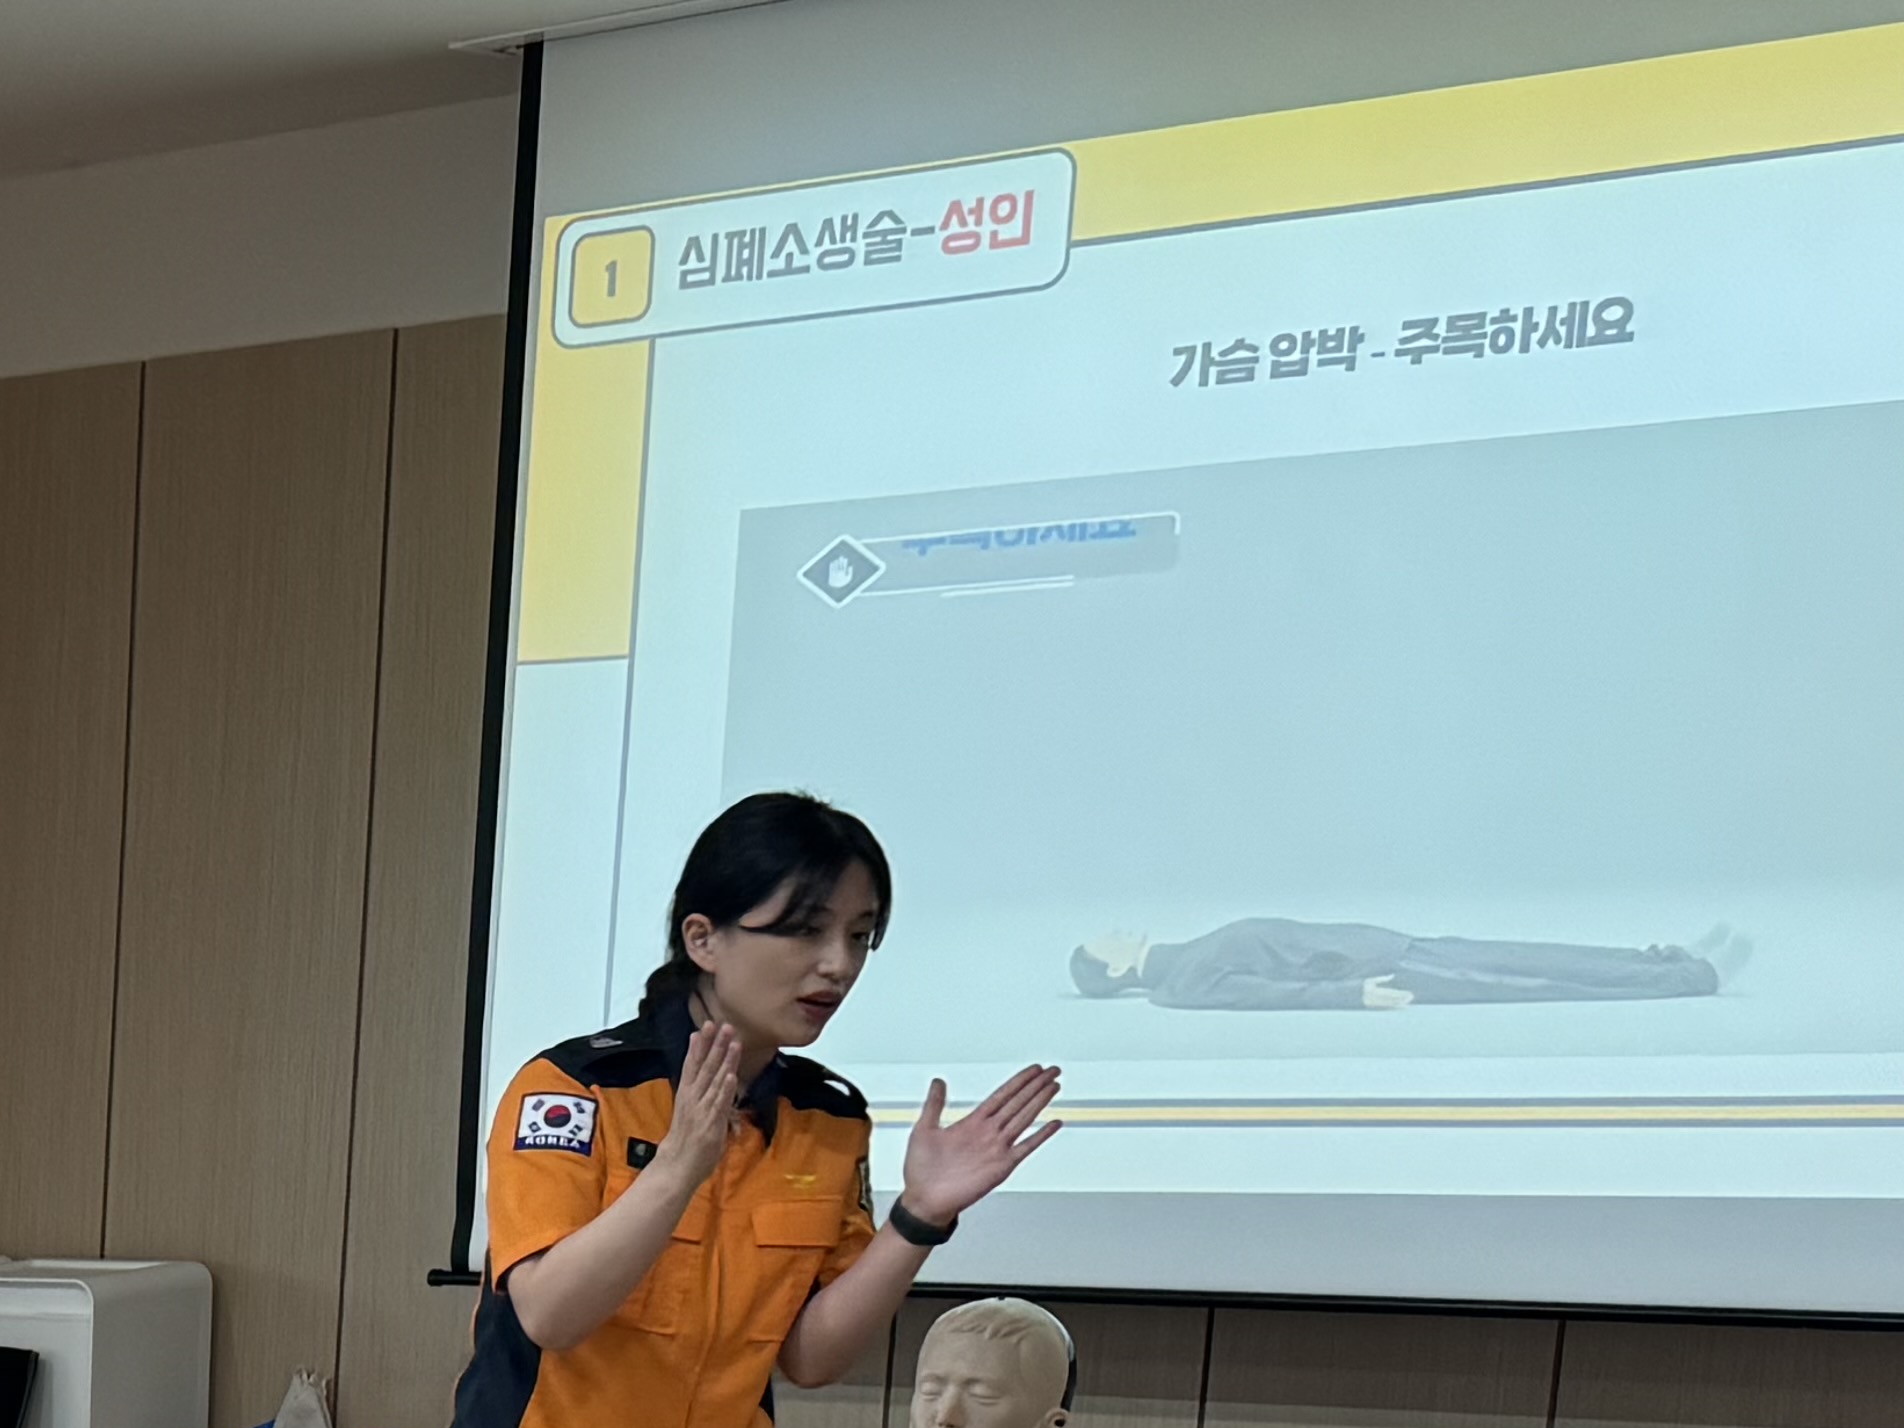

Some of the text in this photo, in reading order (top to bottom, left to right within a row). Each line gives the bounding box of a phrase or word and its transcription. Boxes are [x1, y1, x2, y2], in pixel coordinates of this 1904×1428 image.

[677, 189, 1036, 290] 심폐소생술-성인
[605, 260, 617, 298] 1
[1169, 337, 1260, 388] 가슴
[1269, 325, 1366, 380] 압박
[1393, 295, 1635, 366] 주목하세요
[525, 1134, 581, 1149] KOREA
